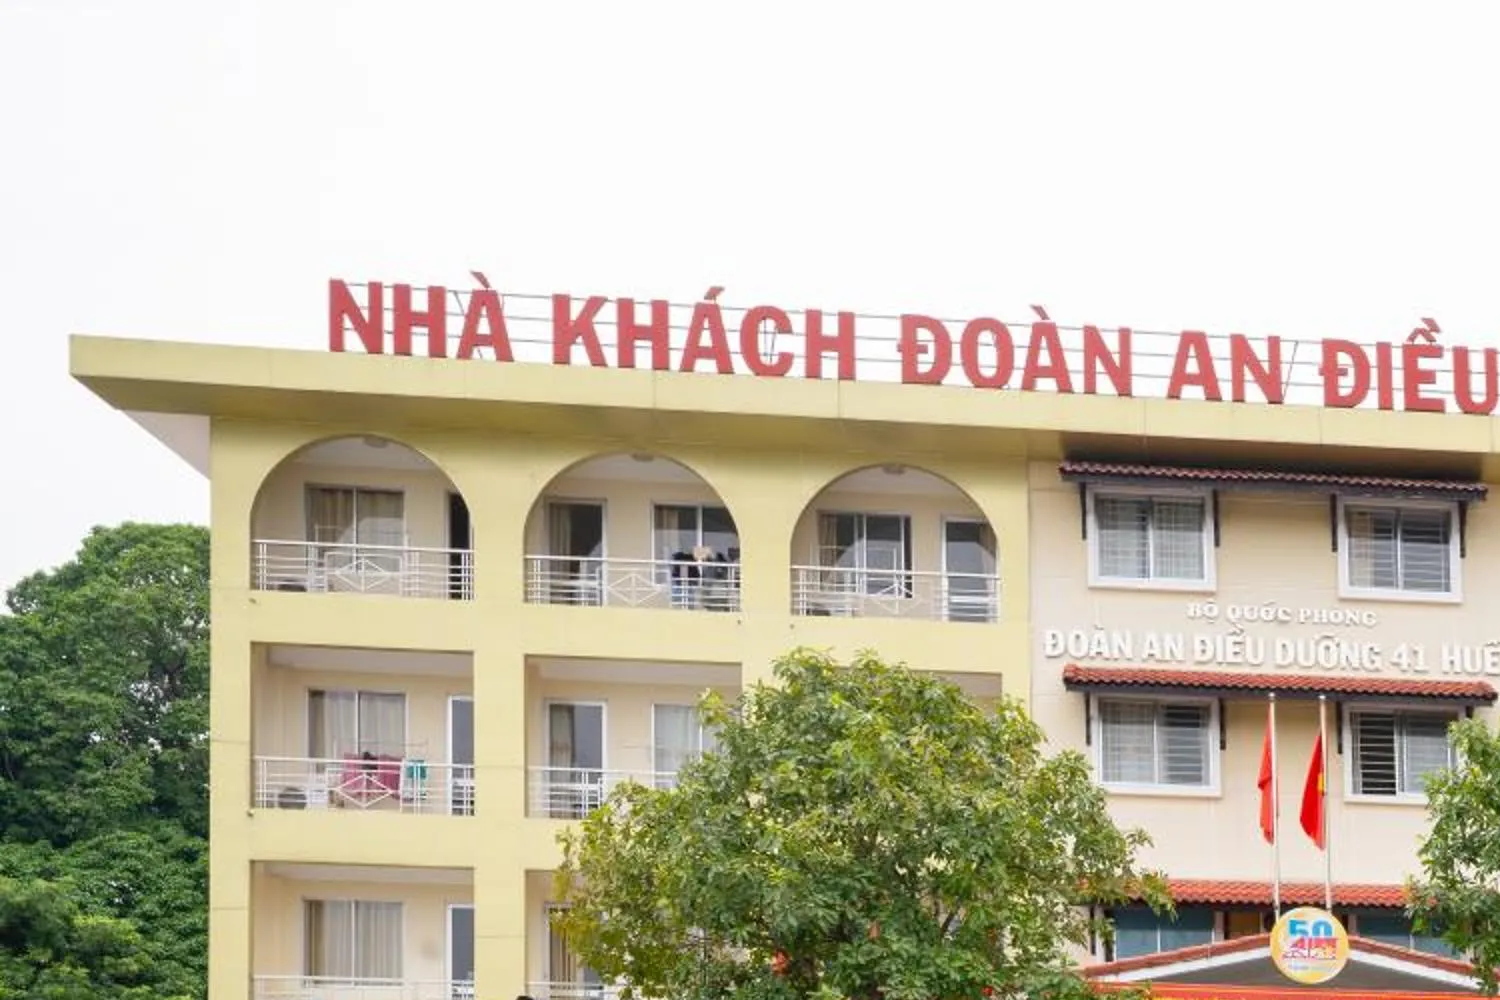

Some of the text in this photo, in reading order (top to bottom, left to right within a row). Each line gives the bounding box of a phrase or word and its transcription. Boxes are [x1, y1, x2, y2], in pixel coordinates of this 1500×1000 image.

[328, 271, 514, 362] NHÀ
[552, 286, 856, 380] KHÁCH
[897, 305, 1132, 397] ĐOÀN
[1166, 331, 1283, 404] AN
[1319, 317, 1498, 415] ĐIỀU
[1043, 626, 1133, 660] ĐOÀN
[1142, 632, 1186, 662] AN
[1193, 623, 1265, 666] ĐIỀU
[1274, 634, 1383, 672] DƯỠNG
[1390, 642, 1431, 674] 41
